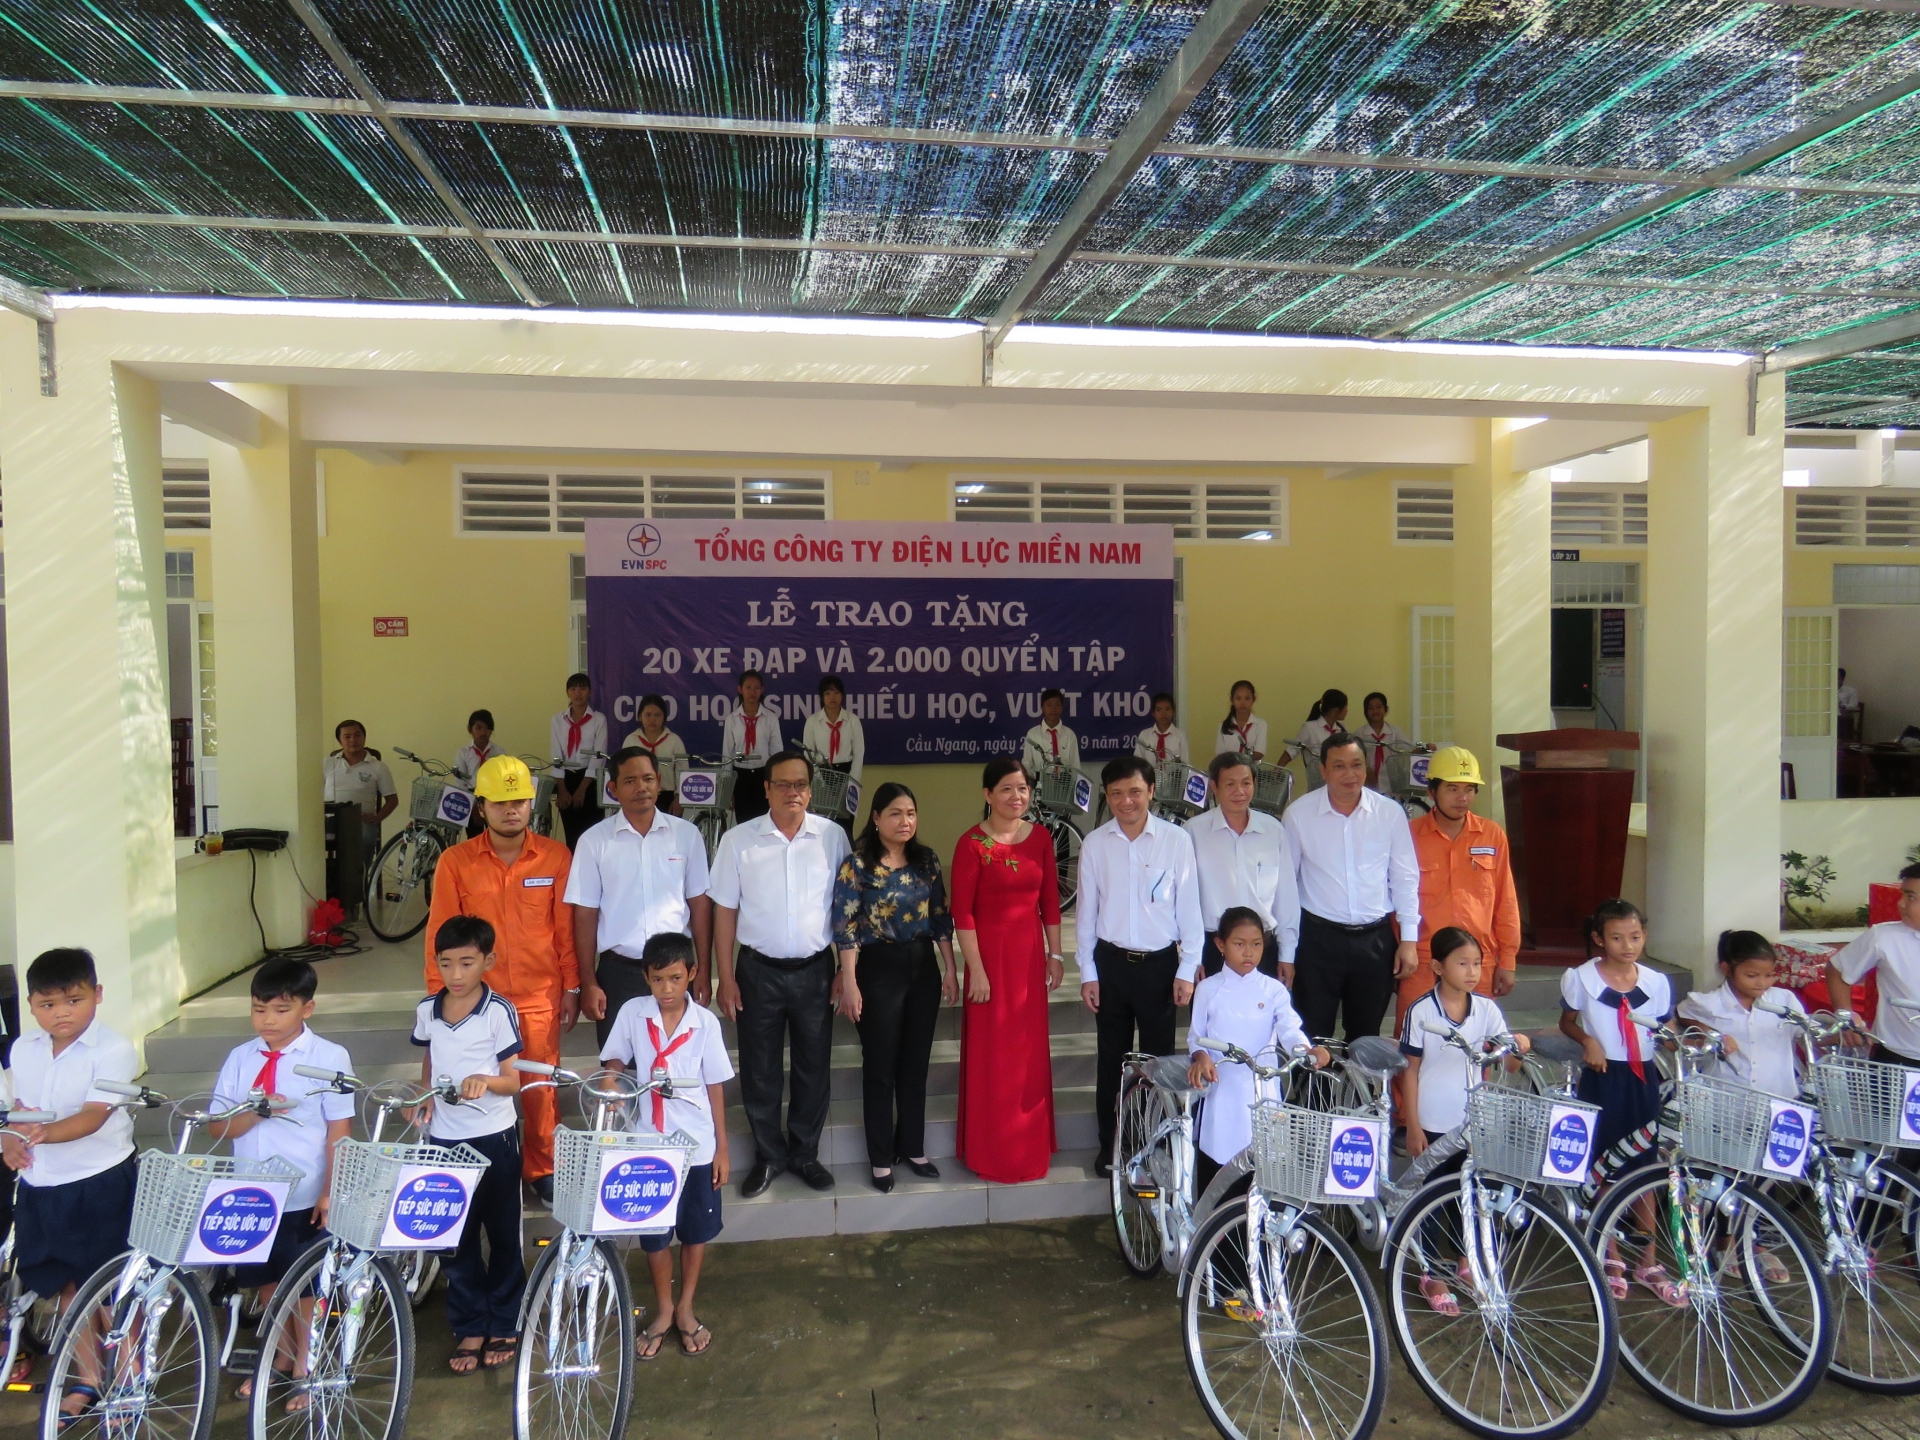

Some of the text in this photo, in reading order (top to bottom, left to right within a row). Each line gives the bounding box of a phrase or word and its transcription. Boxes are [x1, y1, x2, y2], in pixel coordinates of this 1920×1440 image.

[694, 527, 1141, 568] TỔNG CÔNG TY ĐIỆN LỰC MIỀN NAM
[621, 559, 667, 570] EVNSPC
[747, 587, 1028, 632] LỄ TRAO TẶNG
[642, 632, 1125, 678] 20 XE ĐẠP VÀ 2.000 QUYỂN TẬP
[613, 695, 678, 722] CO
[763, 693, 821, 720] SIN
[927, 692, 996, 724] HỌC,
[1006, 687, 1082, 718] VƯT
[1093, 684, 1151, 717] KHÓ
[906, 733, 1138, 755] Cầu Ngang, ngày 2 9 năm 20
[605, 1179, 674, 1199] TIẾP SỨC ƯỚC MƠ
[397, 1194, 464, 1217] TIẾP SỨC ƯỚC MƠ
[621, 1202, 652, 1215] Tặng
[202, 1210, 274, 1232] TIẾP SỨC ƯỚC MƠ
[410, 1219, 440, 1233] Tặng
[216, 1235, 248, 1249] Tặng
